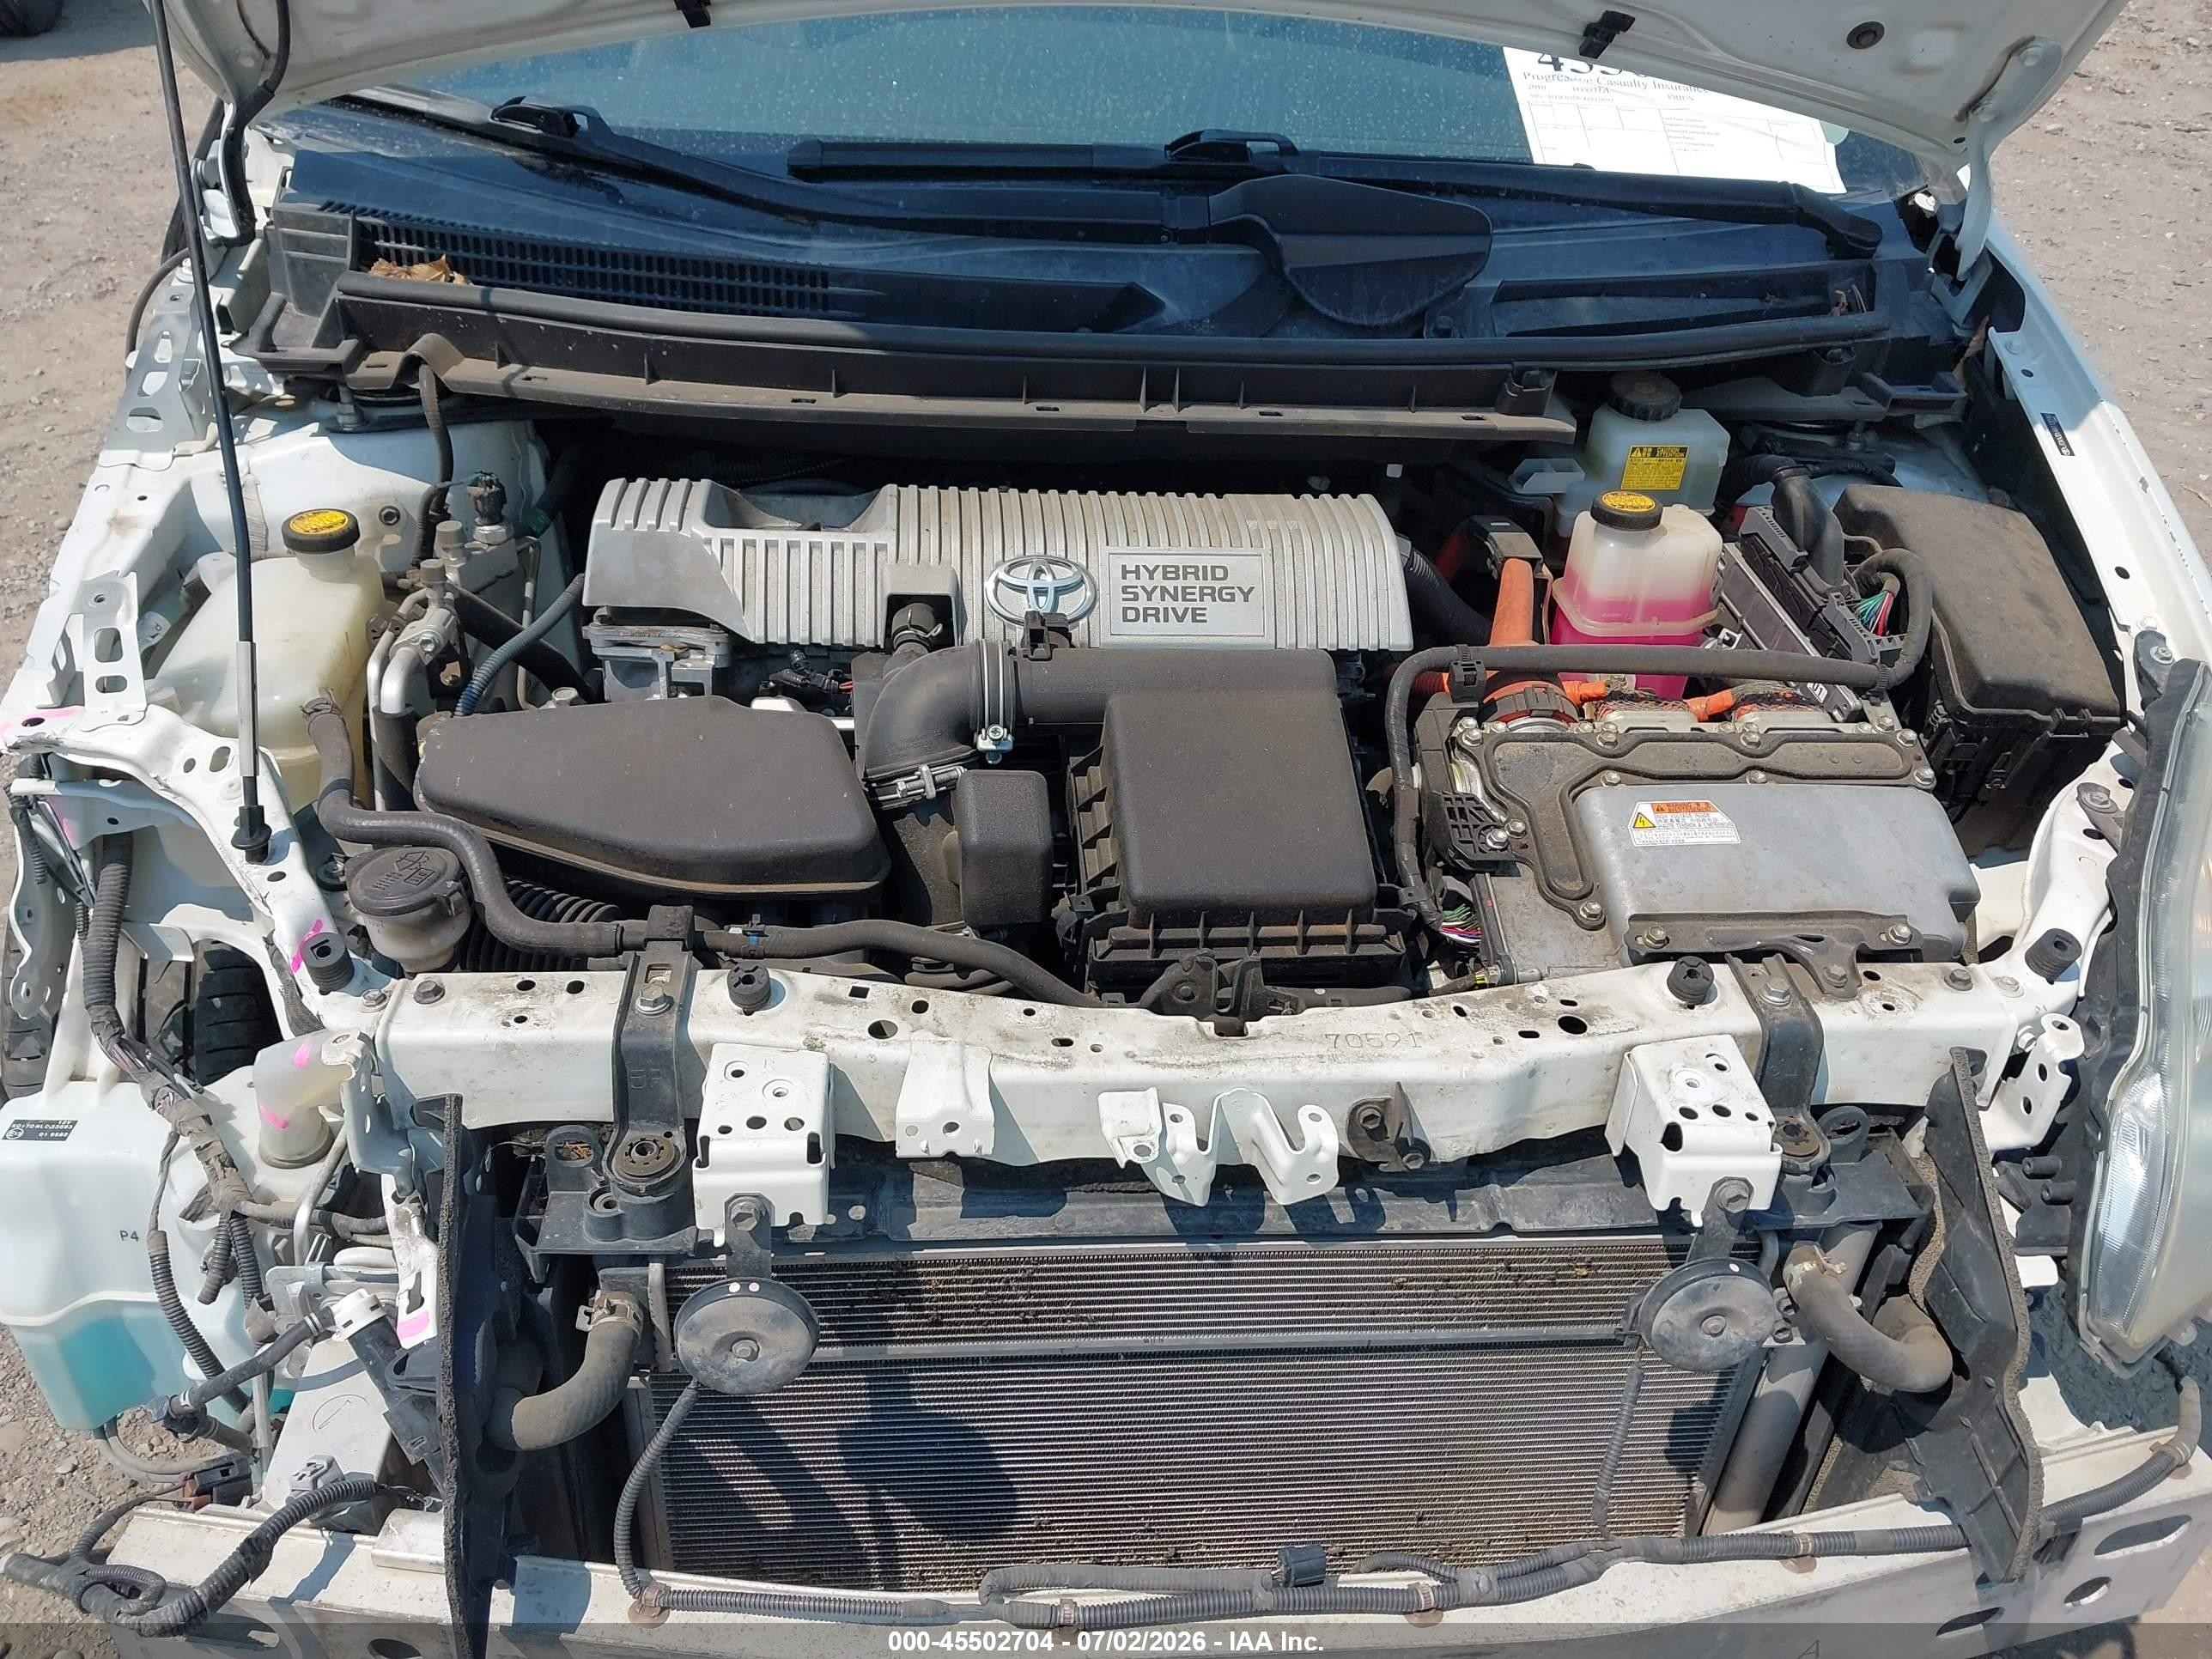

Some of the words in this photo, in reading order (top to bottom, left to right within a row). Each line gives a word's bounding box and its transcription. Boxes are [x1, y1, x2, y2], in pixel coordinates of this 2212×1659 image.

[1595, 76, 1648, 90] Casualty
[1121, 564, 1229, 581] HYBRID
[1121, 585, 1255, 603] SYNERGY
[1121, 606, 1208, 623] DRIVE
[1325, 1033, 1423, 1048] 70591
[119, 1230, 140, 1243] P4
